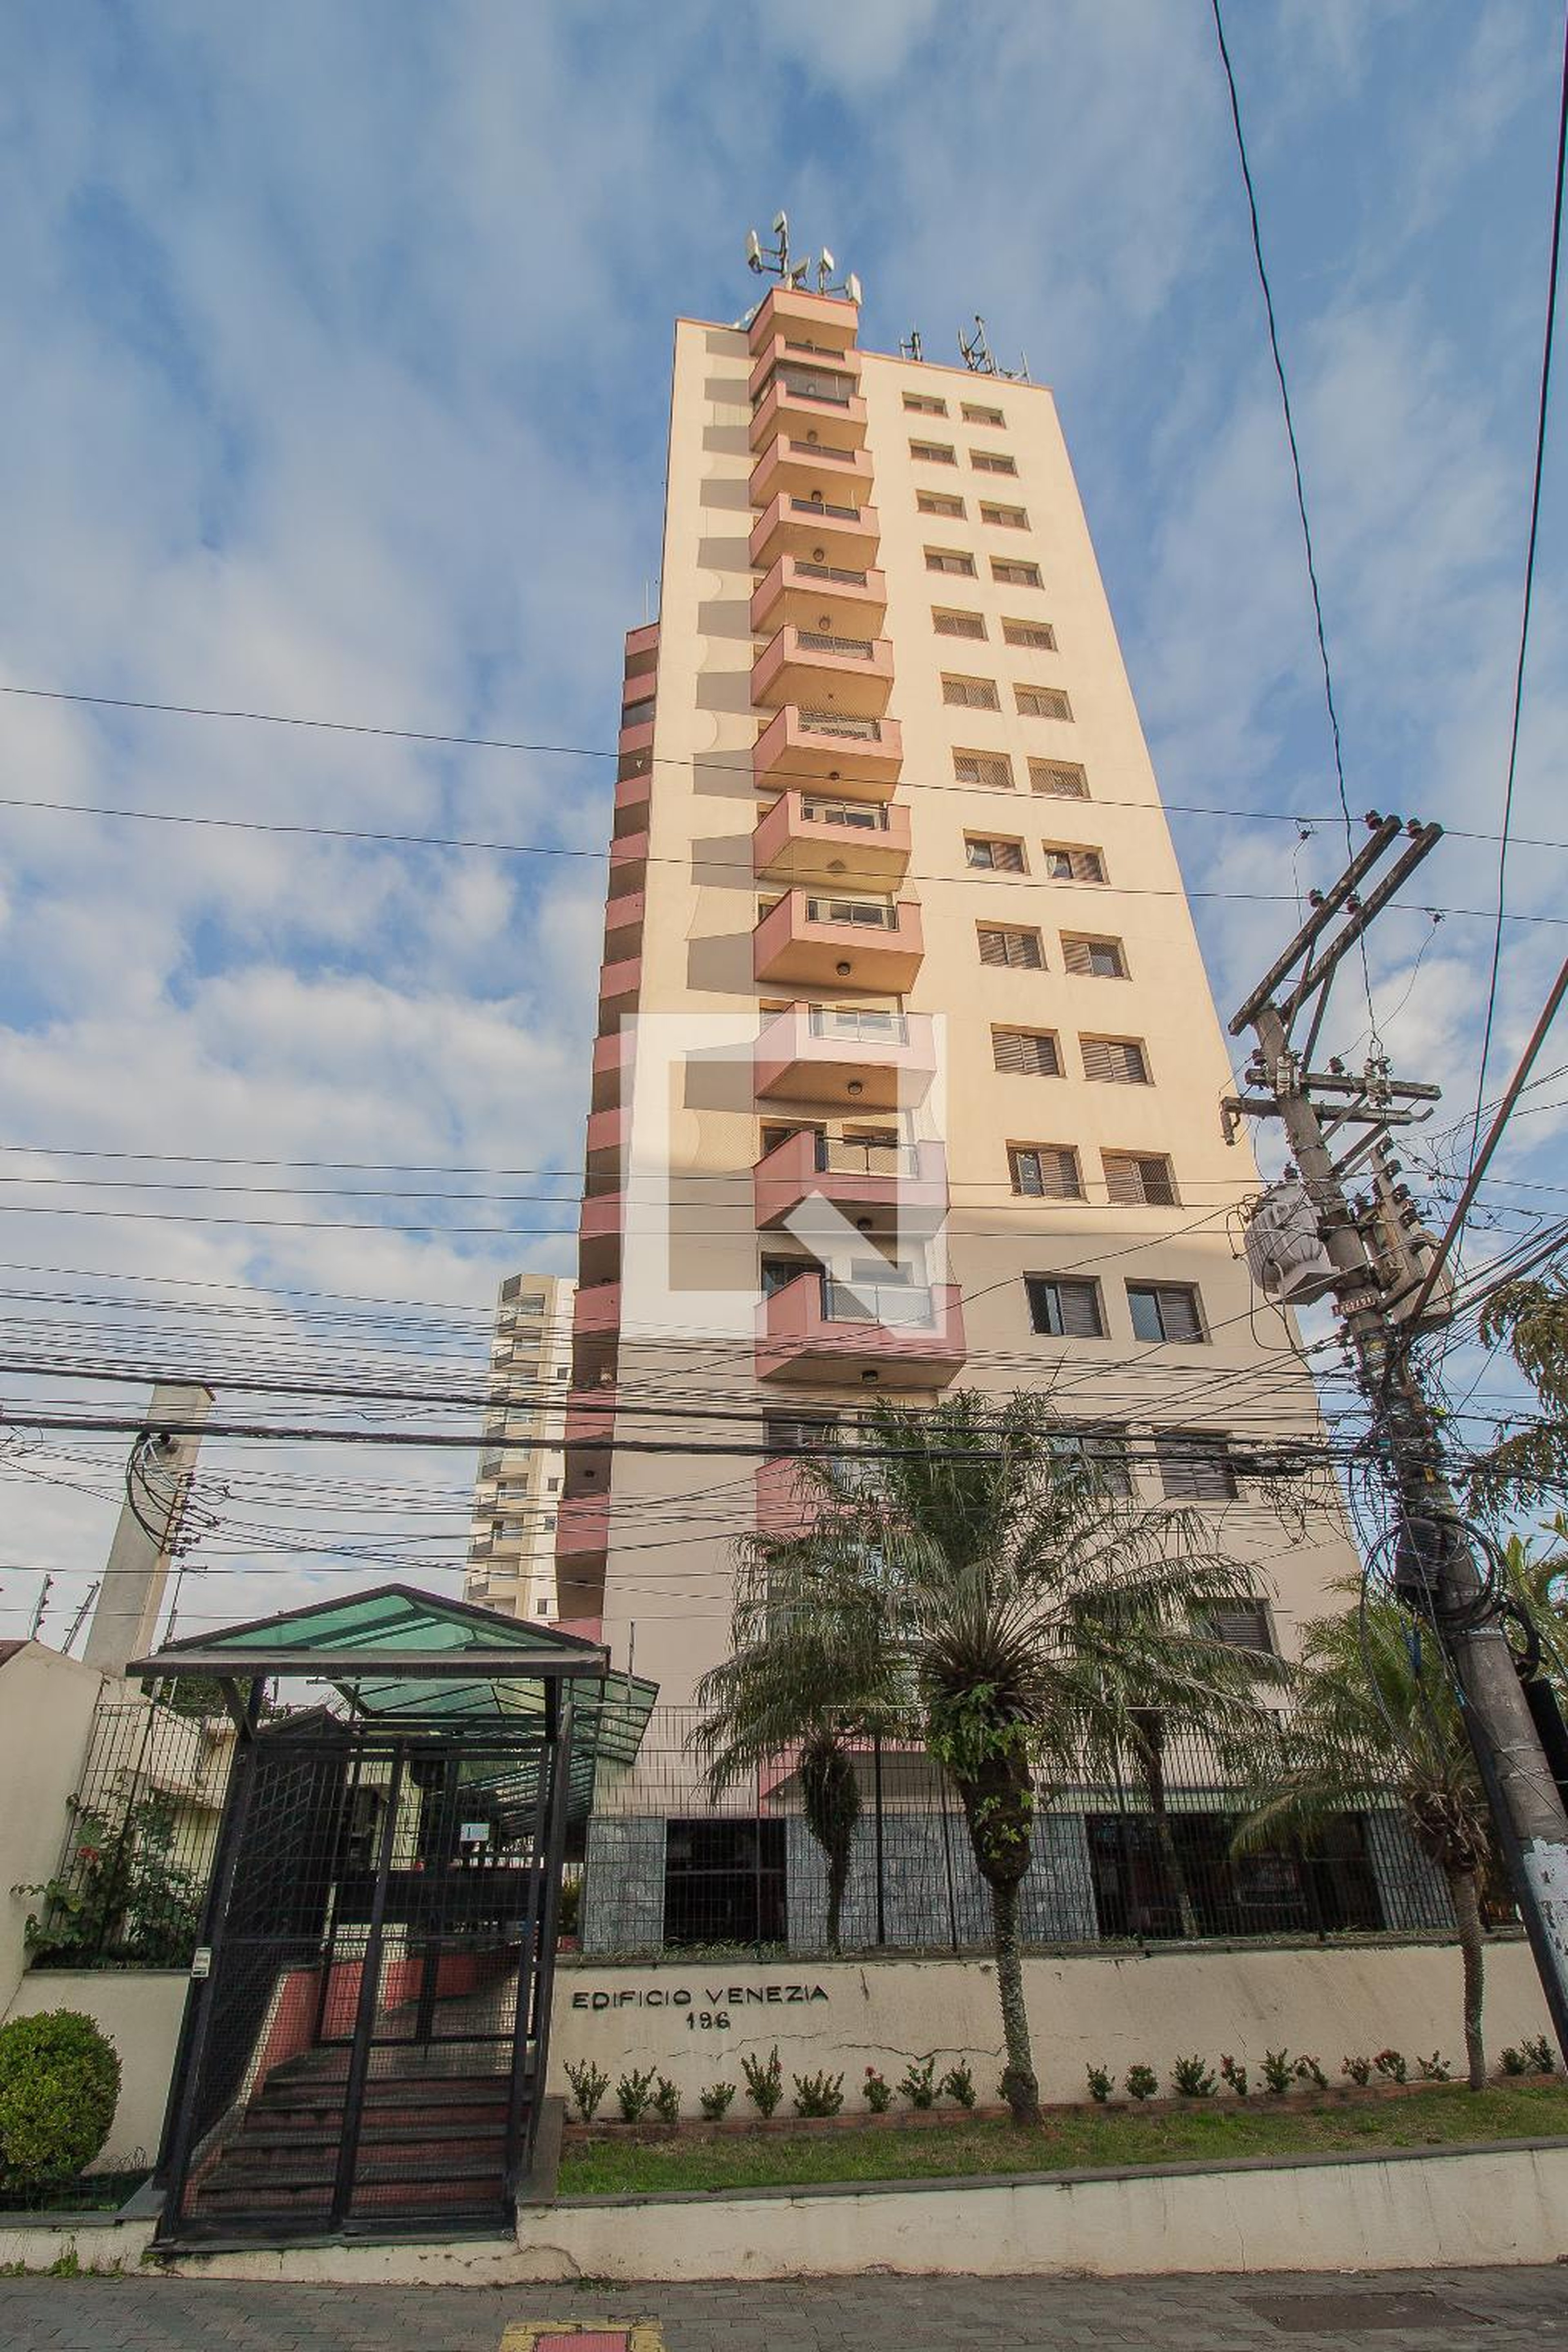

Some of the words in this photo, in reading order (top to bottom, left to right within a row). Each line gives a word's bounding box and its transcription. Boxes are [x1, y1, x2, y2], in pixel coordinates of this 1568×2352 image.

[572, 1989, 692, 2009] EDIFICIO
[705, 1984, 829, 2005] VENEZIA
[686, 2011, 731, 2029] 196
